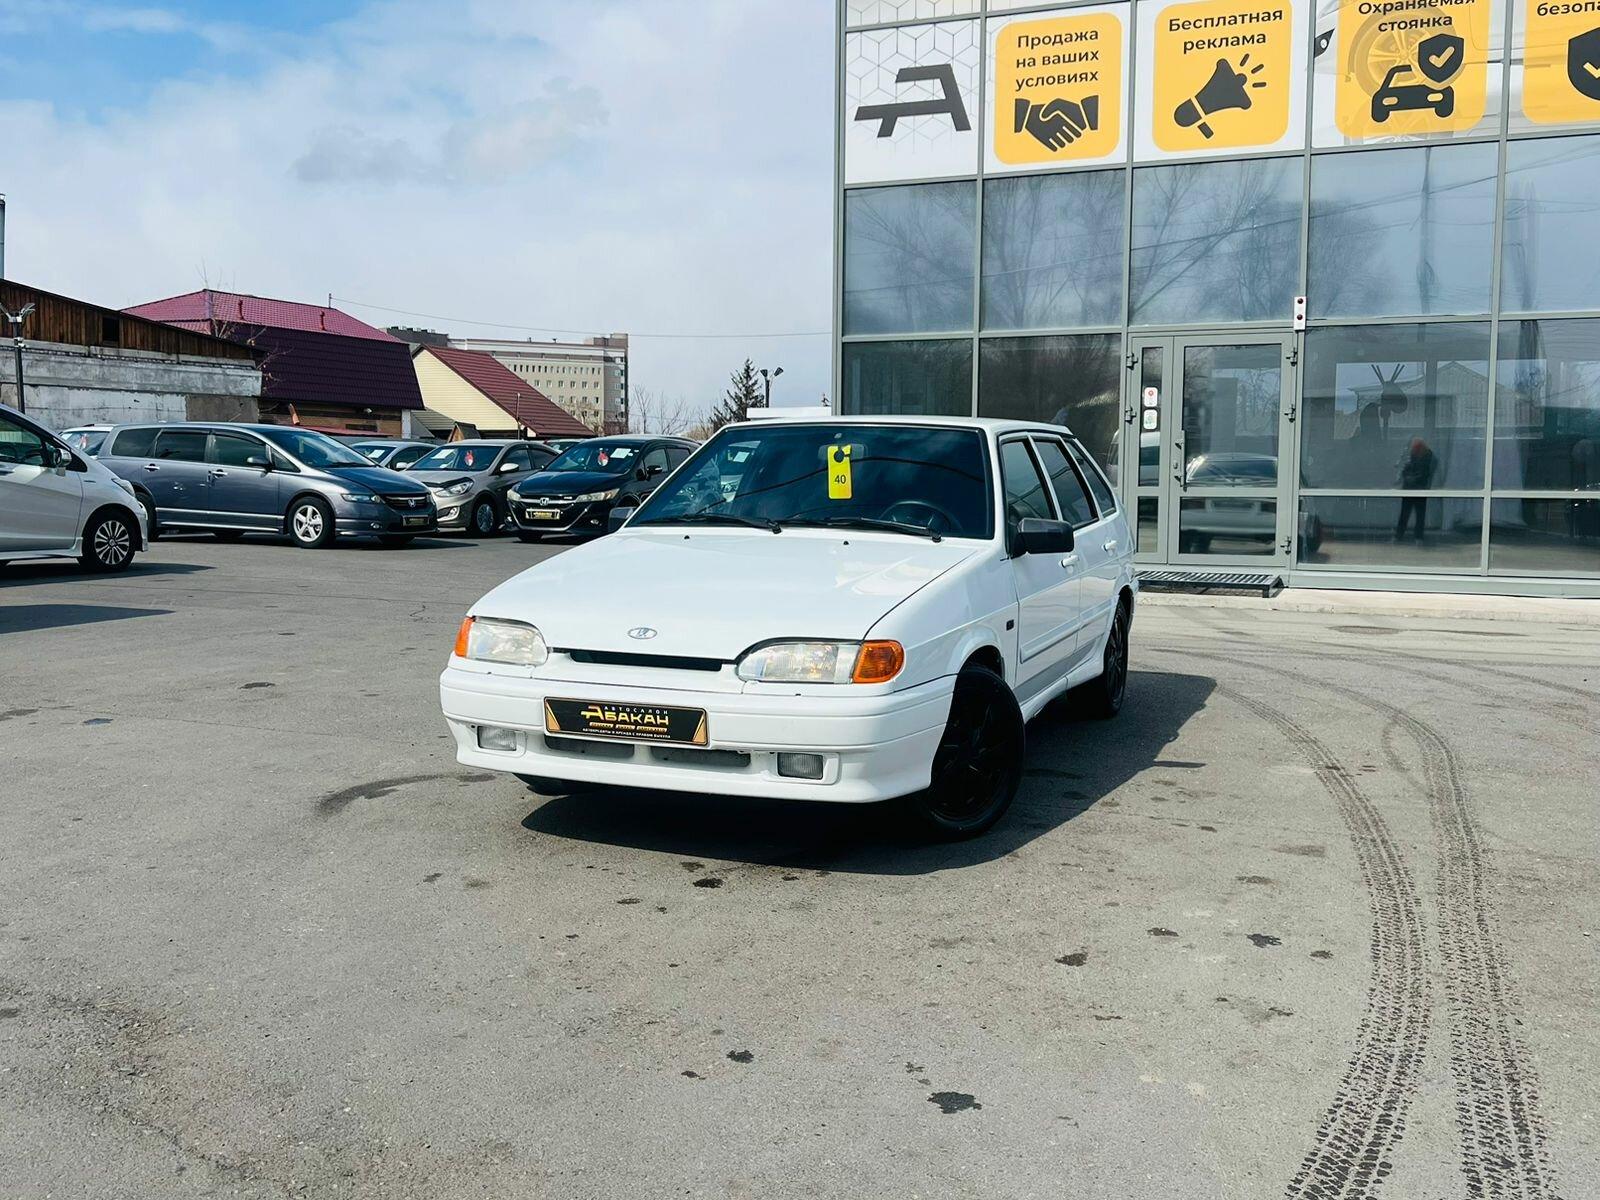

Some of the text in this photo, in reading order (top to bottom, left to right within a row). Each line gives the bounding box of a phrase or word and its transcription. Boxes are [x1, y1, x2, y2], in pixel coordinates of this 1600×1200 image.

[1168, 9, 1283, 32] Бесплатная
[1378, 15, 1453, 32] стоянка
[1017, 28, 1099, 50] Продажа
[1183, 33, 1266, 54] реклама
[1016, 49, 1099, 69] на ваших
[1015, 70, 1099, 92] условиях
[834, 474, 847, 484] 40
[604, 706, 668, 715] АВТОСАЛОН
